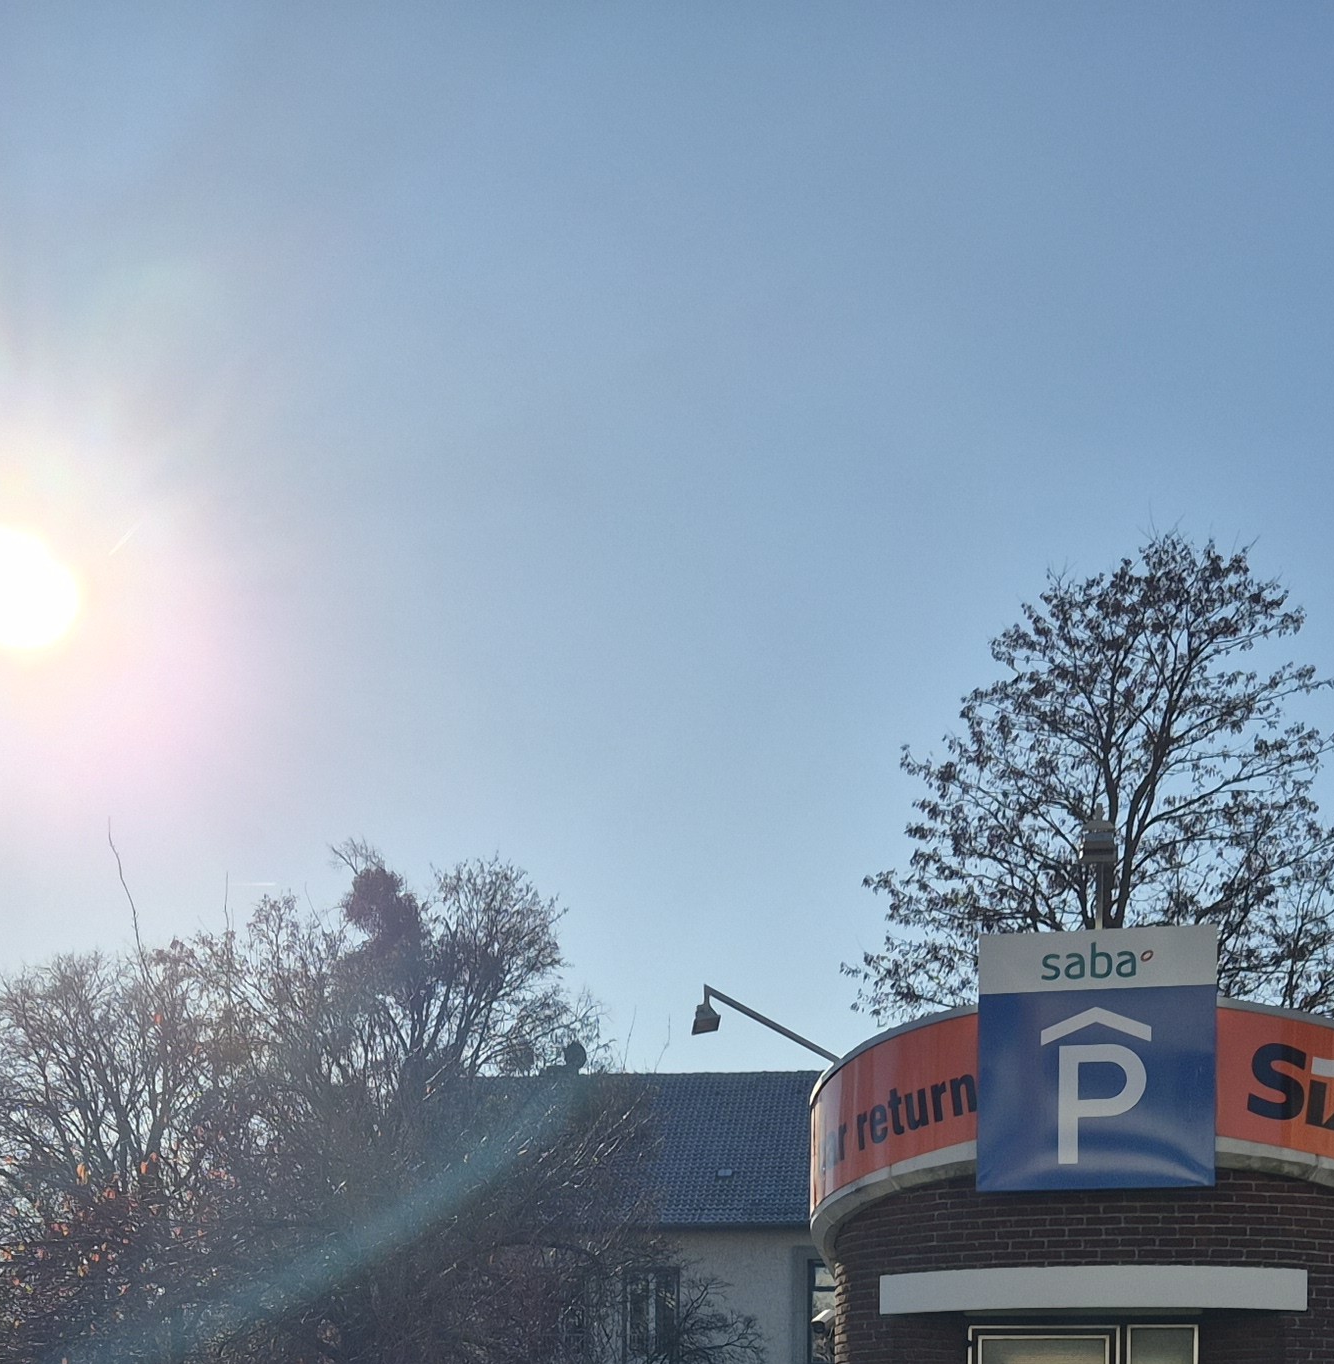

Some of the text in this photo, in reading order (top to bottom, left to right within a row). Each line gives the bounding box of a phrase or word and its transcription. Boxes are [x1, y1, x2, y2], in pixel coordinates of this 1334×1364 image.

[1041, 941, 1137, 981] saba
[856, 1073, 978, 1151] return
[1058, 1043, 1147, 1165] P
